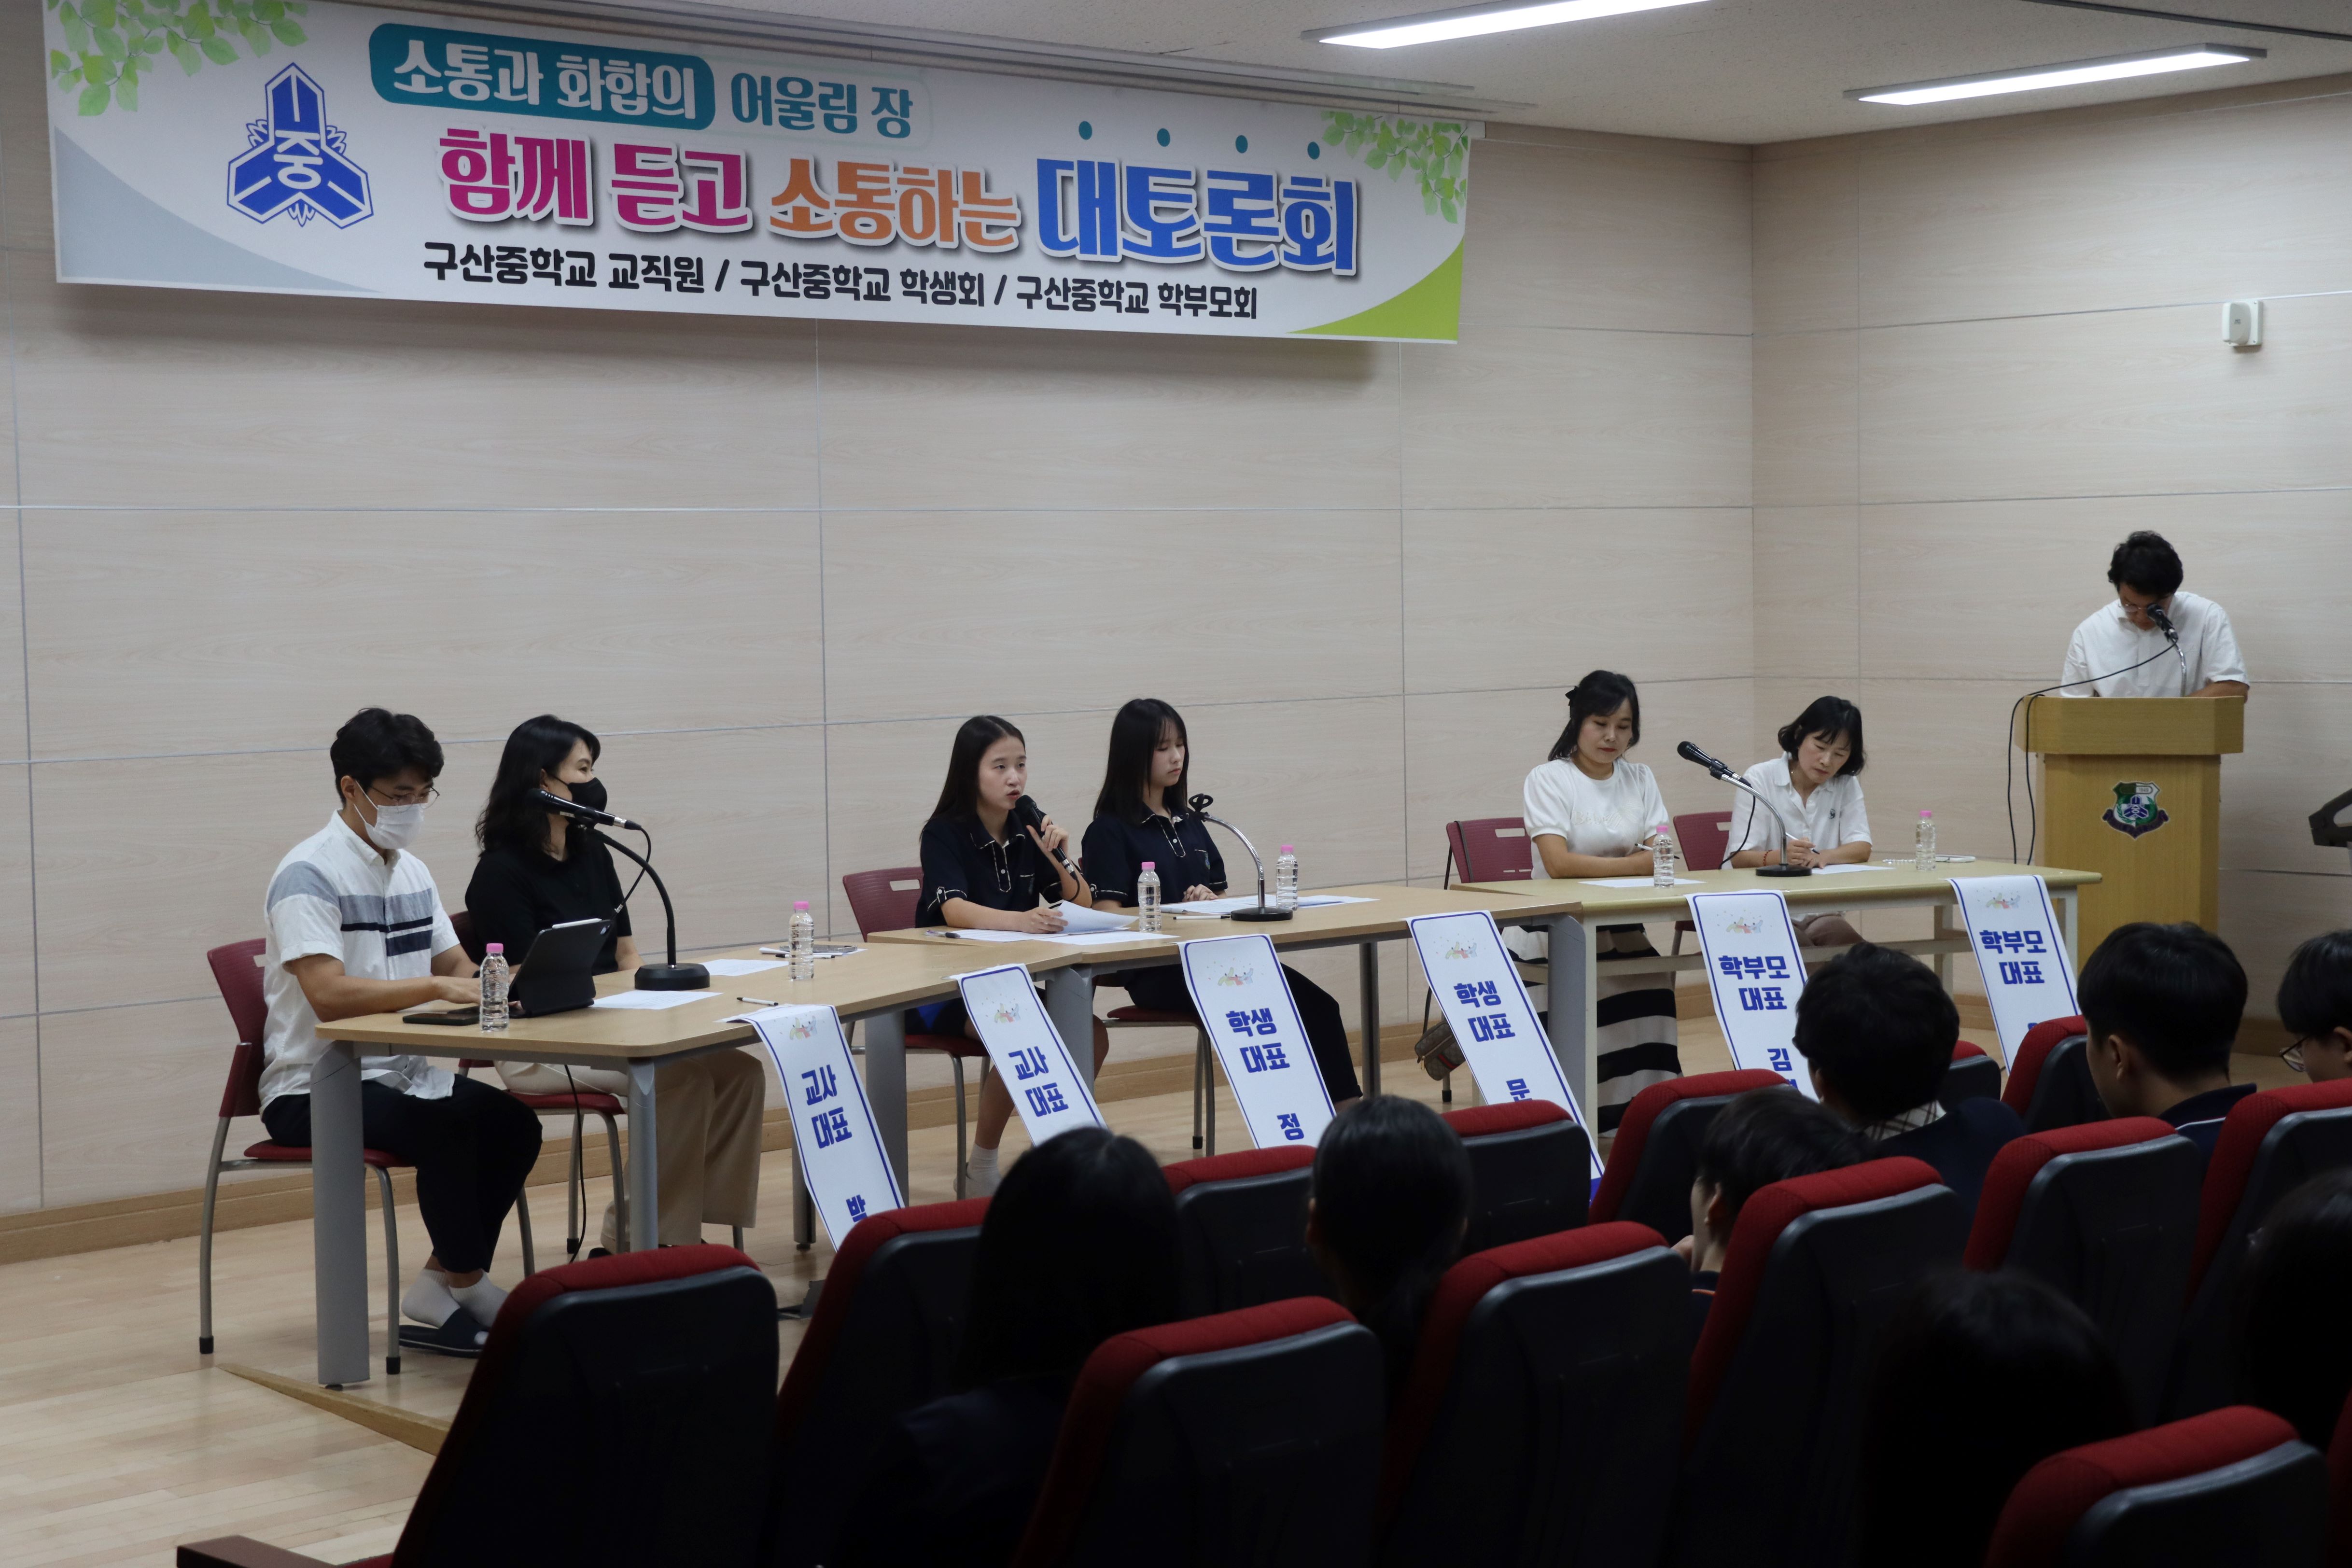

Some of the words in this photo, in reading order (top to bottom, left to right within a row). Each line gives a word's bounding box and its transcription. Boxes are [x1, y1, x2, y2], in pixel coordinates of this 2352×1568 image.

[393, 39, 544, 106] 소통과
[556, 54, 696, 120] 화합의
[731, 73, 858, 134] 어울림
[872, 87, 912, 139] 장
[440, 129, 588, 218] 함께
[612, 144, 747, 226] 듣고
[771, 160, 1016, 246] 소통하는
[1037, 159, 1353, 270] 대토론회
[424, 242, 597, 287] 구산중학교
[608, 253, 704, 294] 교직원
[714, 259, 730, 292] /
[741, 260, 891, 302] 구산중학교
[899, 268, 984, 307] 학생회
[994, 275, 1007, 305] /
[1017, 276, 1149, 314] 구산중학교
[1157, 282, 1257, 319] 학부모회
[1979, 930, 2047, 955] 학부모
[1718, 955, 1791, 980] 학부모
[2000, 961, 2045, 985] 대표
[1454, 980, 1502, 1008] 학생
[1739, 987, 1788, 1011] 대표
[1225, 1008, 1277, 1037] 학생
[1468, 1013, 1515, 1043] 대표
[1008, 1046, 1049, 1080] 교사
[1240, 1042, 1290, 1073] 대표
[1767, 1048, 1792, 1071] 김
[801, 1064, 838, 1106] 교사
[1024, 1082, 1069, 1117] 대표
[811, 1106, 853, 1149] 대표
[1277, 1113, 1304, 1141] 정
